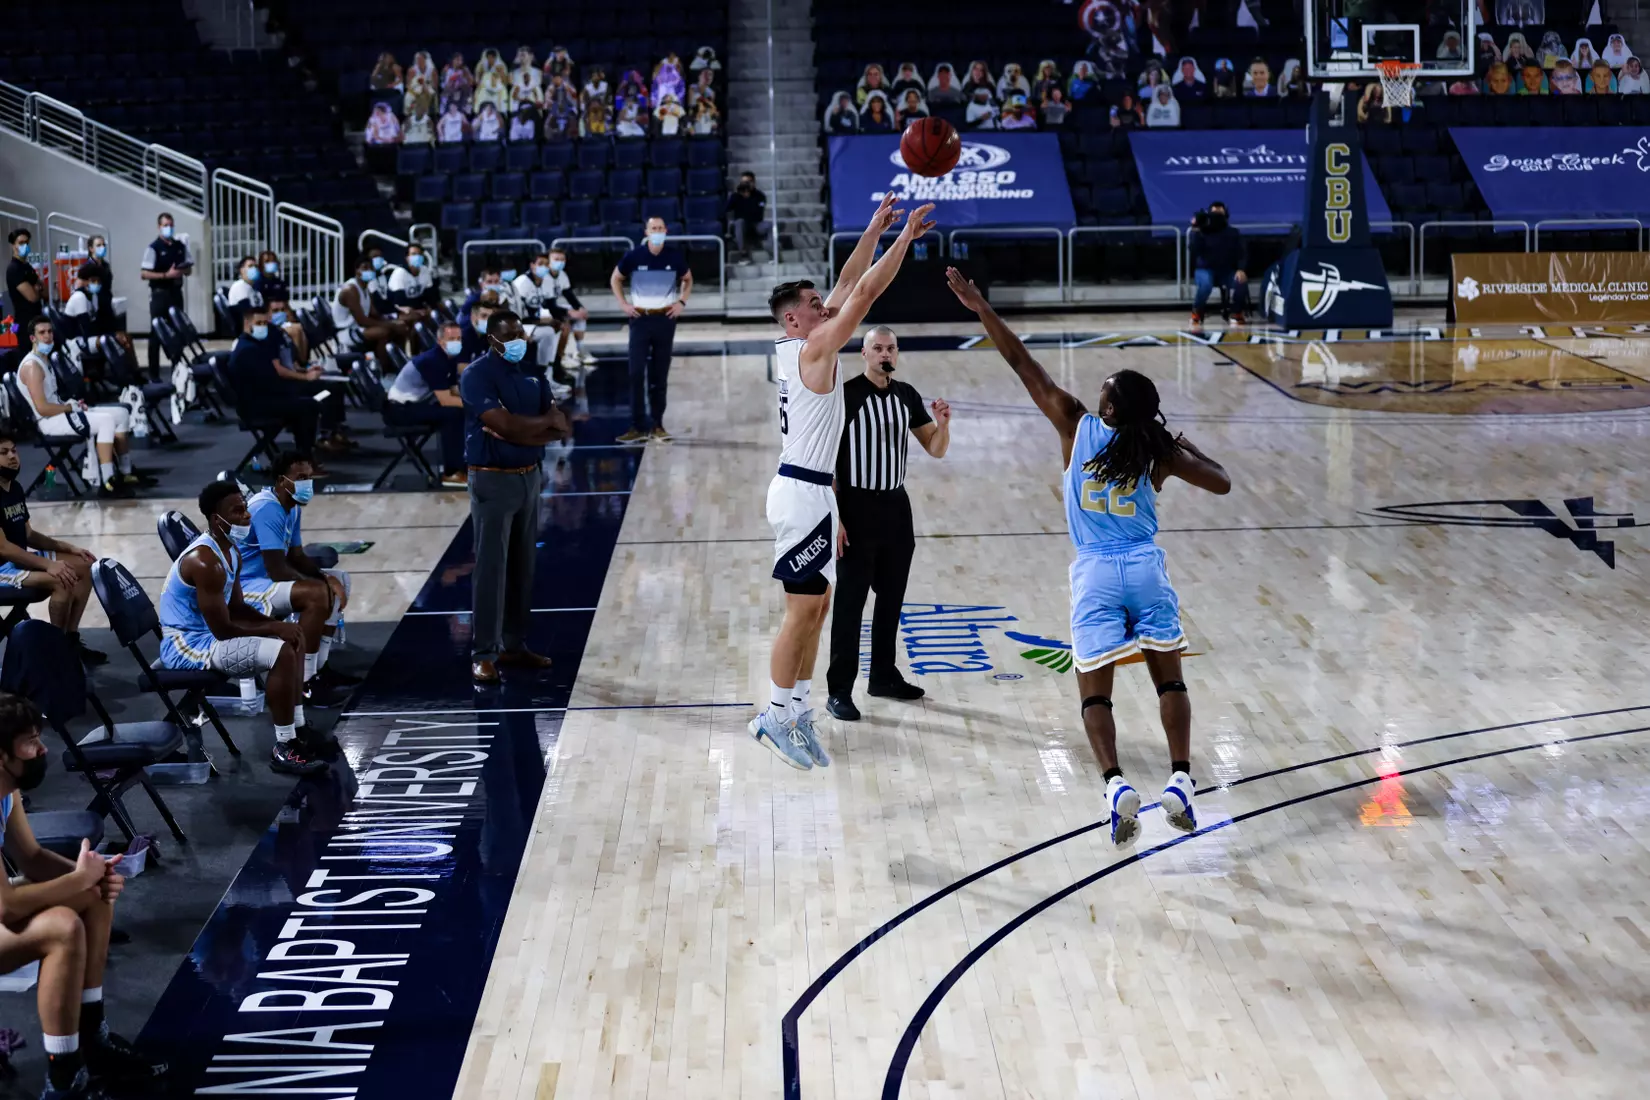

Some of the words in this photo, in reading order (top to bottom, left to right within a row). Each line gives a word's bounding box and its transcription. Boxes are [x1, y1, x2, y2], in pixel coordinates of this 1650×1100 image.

[1165, 155, 1240, 165] AYRES
[1483, 154, 1553, 171] Goose
[1552, 153, 1625, 168] Creek
[1520, 164, 1552, 172] GOLF
[1557, 163, 1593, 171] CLUB
[1203, 175, 1249, 183] ELEVATE
[1253, 174, 1284, 182] YOUR
[914, 189, 1034, 201] BERNARDINO
[1325, 143, 1352, 243] CBU
[1482, 283, 1548, 294] RIVERSIDE
[1551, 282, 1606, 293] MEDICAL
[1608, 281, 1649, 292] CLINIC
[1588, 293, 1629, 302] Legendary
[1630, 293, 1649, 301] Care
[788, 534, 828, 573] LANCERS
[899, 602, 1020, 676] Altura
[319, 718, 500, 861] UNIVERSITY
[237, 868, 442, 1013] BAPTIST
[193, 1020, 384, 1100] NIA
